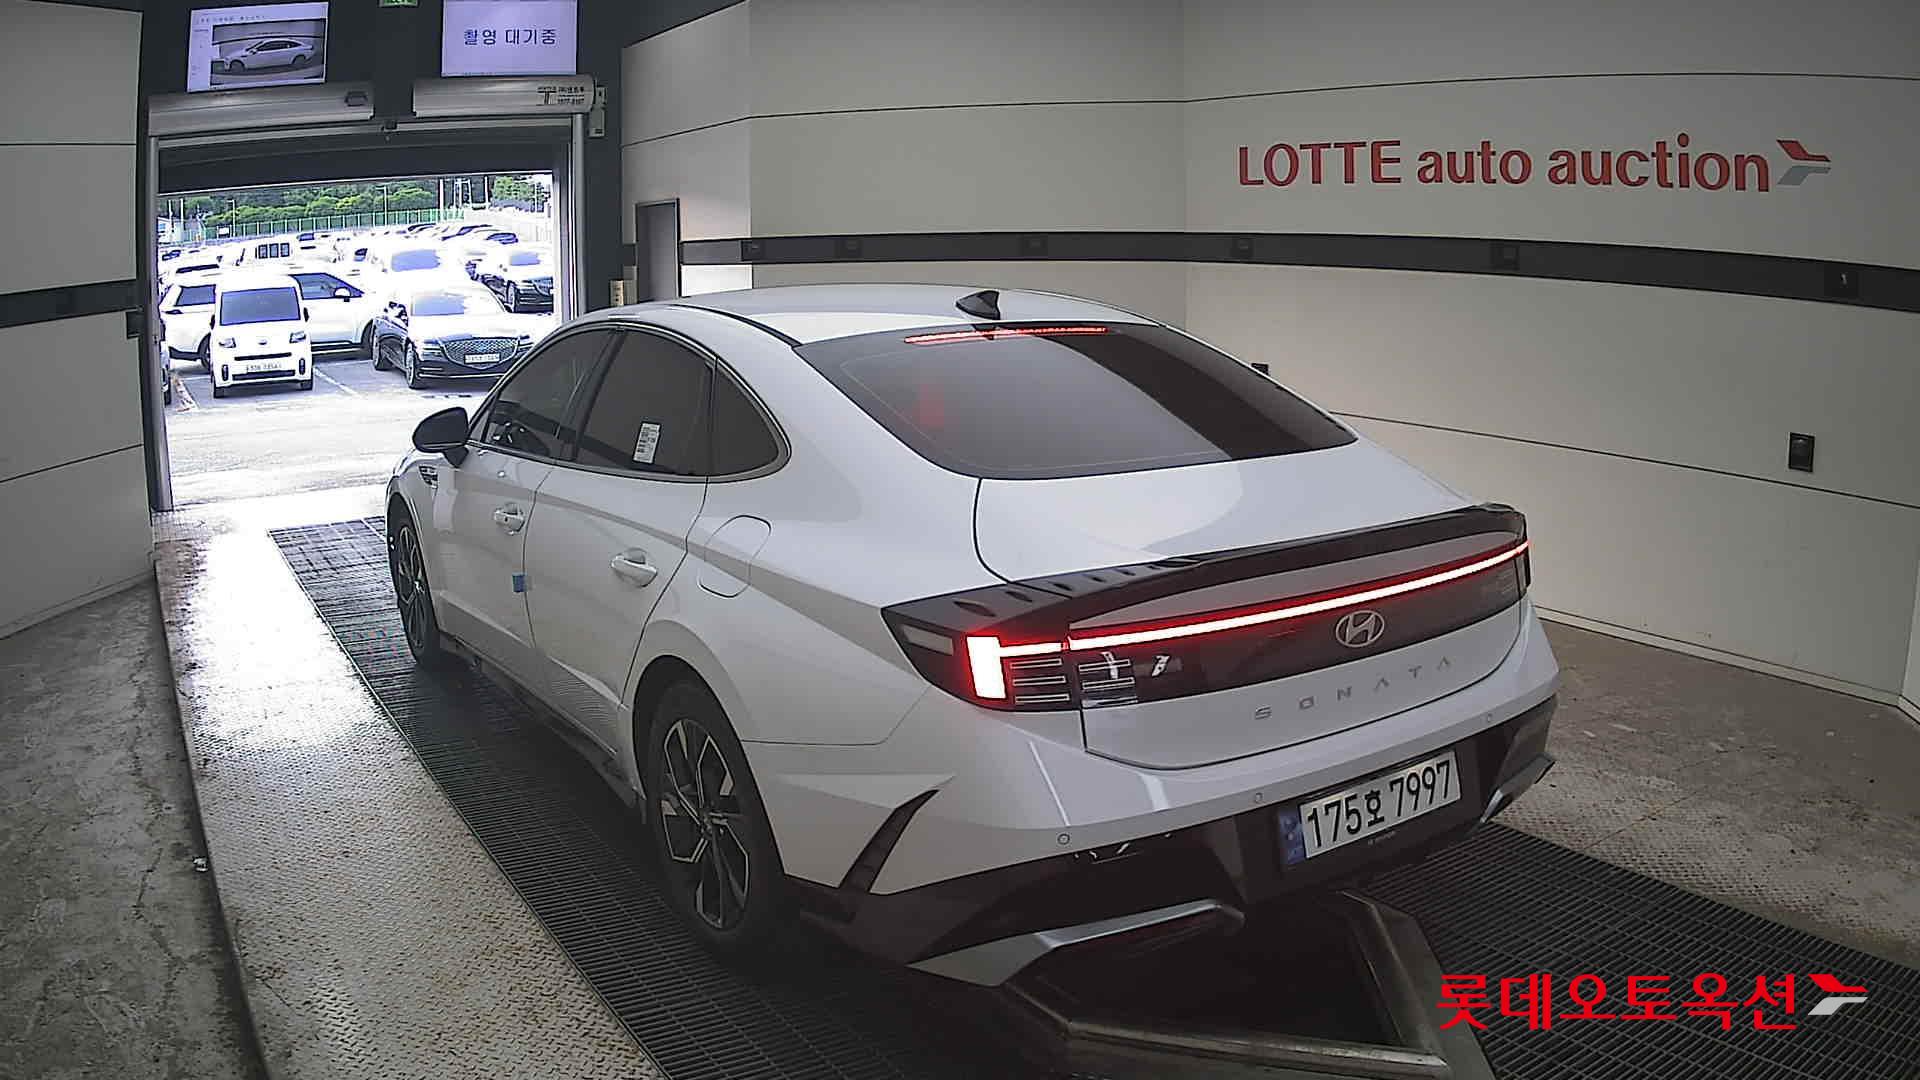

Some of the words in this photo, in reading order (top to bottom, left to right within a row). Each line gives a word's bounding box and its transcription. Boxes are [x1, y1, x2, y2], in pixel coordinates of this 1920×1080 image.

[463, 29, 497, 46] 촬영
[504, 28, 557, 46] 대기중
[1238, 140, 1400, 186] LOTTE
[1416, 140, 1533, 185] auto
[1547, 133, 1770, 192] auction
[1254, 656, 1451, 720] SONATA
[1389, 759, 1451, 818] 7997
